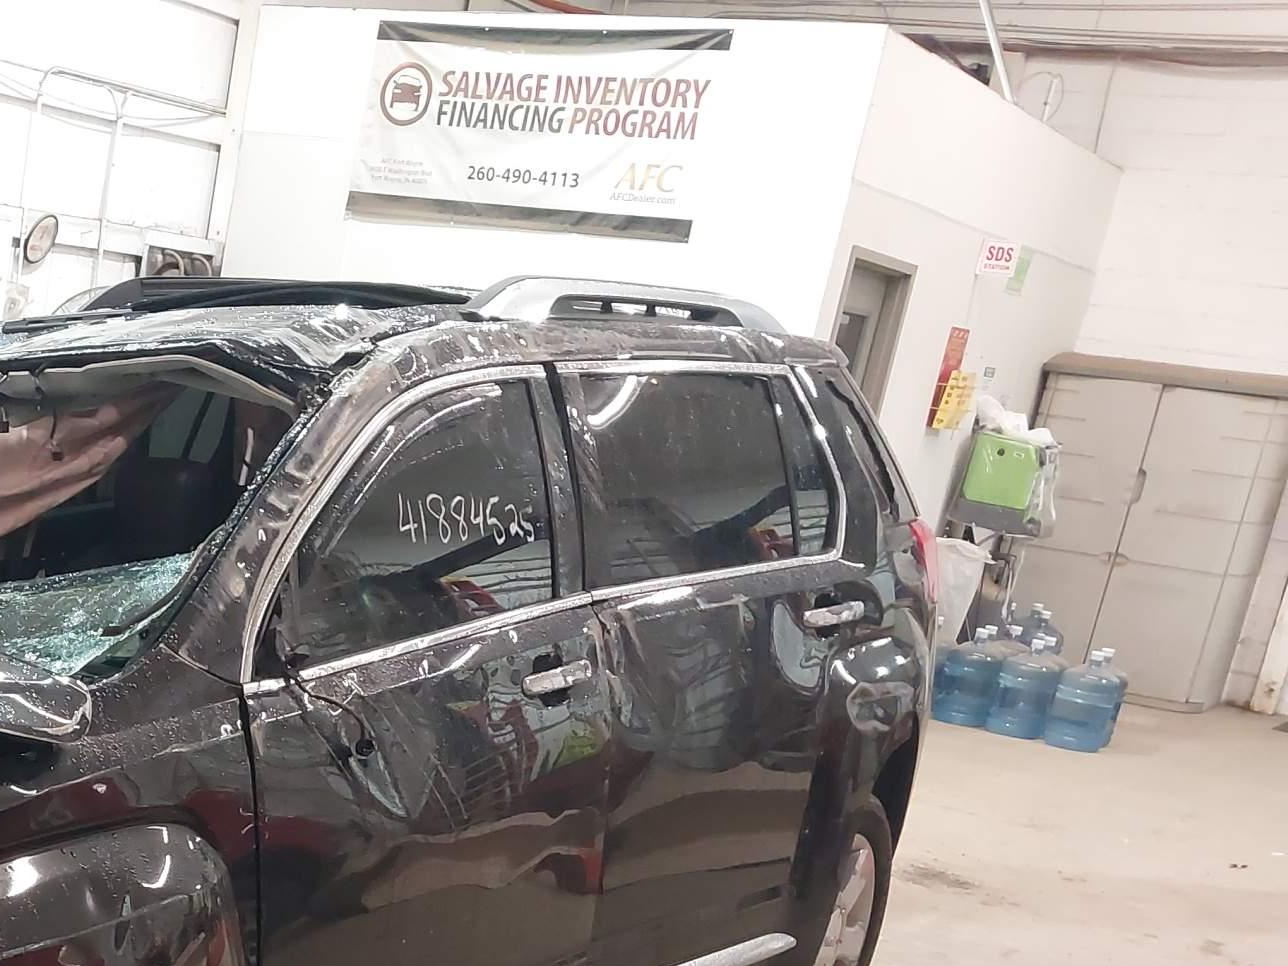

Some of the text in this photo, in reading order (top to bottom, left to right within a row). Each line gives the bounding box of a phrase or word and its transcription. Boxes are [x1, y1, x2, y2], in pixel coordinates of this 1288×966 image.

[438, 69, 711, 109] SALVAGE INVENTORY
[436, 100, 699, 140] FINANCING PROGRAM
[467, 165, 580, 188] 260-490-4113
[614, 162, 684, 193] AFC
[986, 245, 1014, 262] SDS
[398, 492, 535, 545] 41884525
